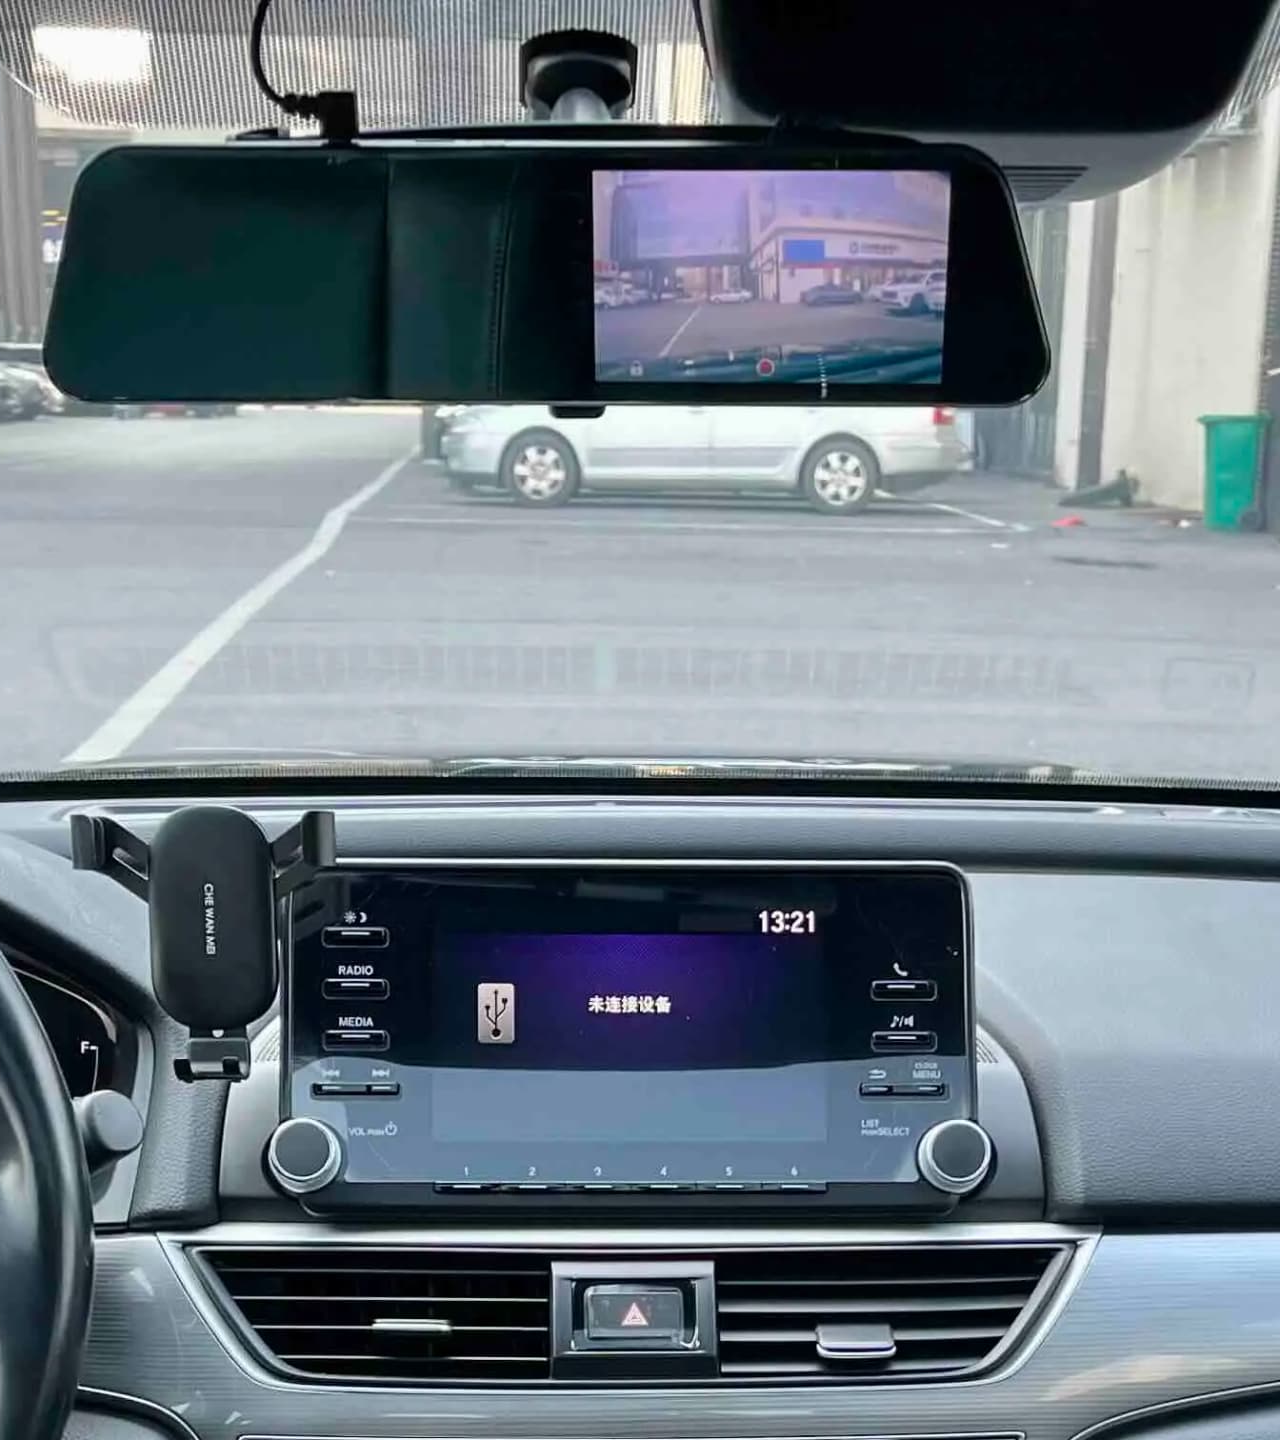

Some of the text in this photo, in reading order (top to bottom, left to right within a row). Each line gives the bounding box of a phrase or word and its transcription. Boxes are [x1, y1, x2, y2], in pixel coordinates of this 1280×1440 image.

[203, 883, 215, 907] CHE
[205, 907, 216, 934] WAN
[758, 910, 816, 934] 13:21
[337, 965, 375, 976] RADIO
[588, 995, 672, 1014] 未连接设备
[338, 1017, 375, 1027] MEDIA
[81, 1041, 90, 1054] F
[912, 1070, 941, 1079] MENU
[861, 1119, 879, 1128] LIST
